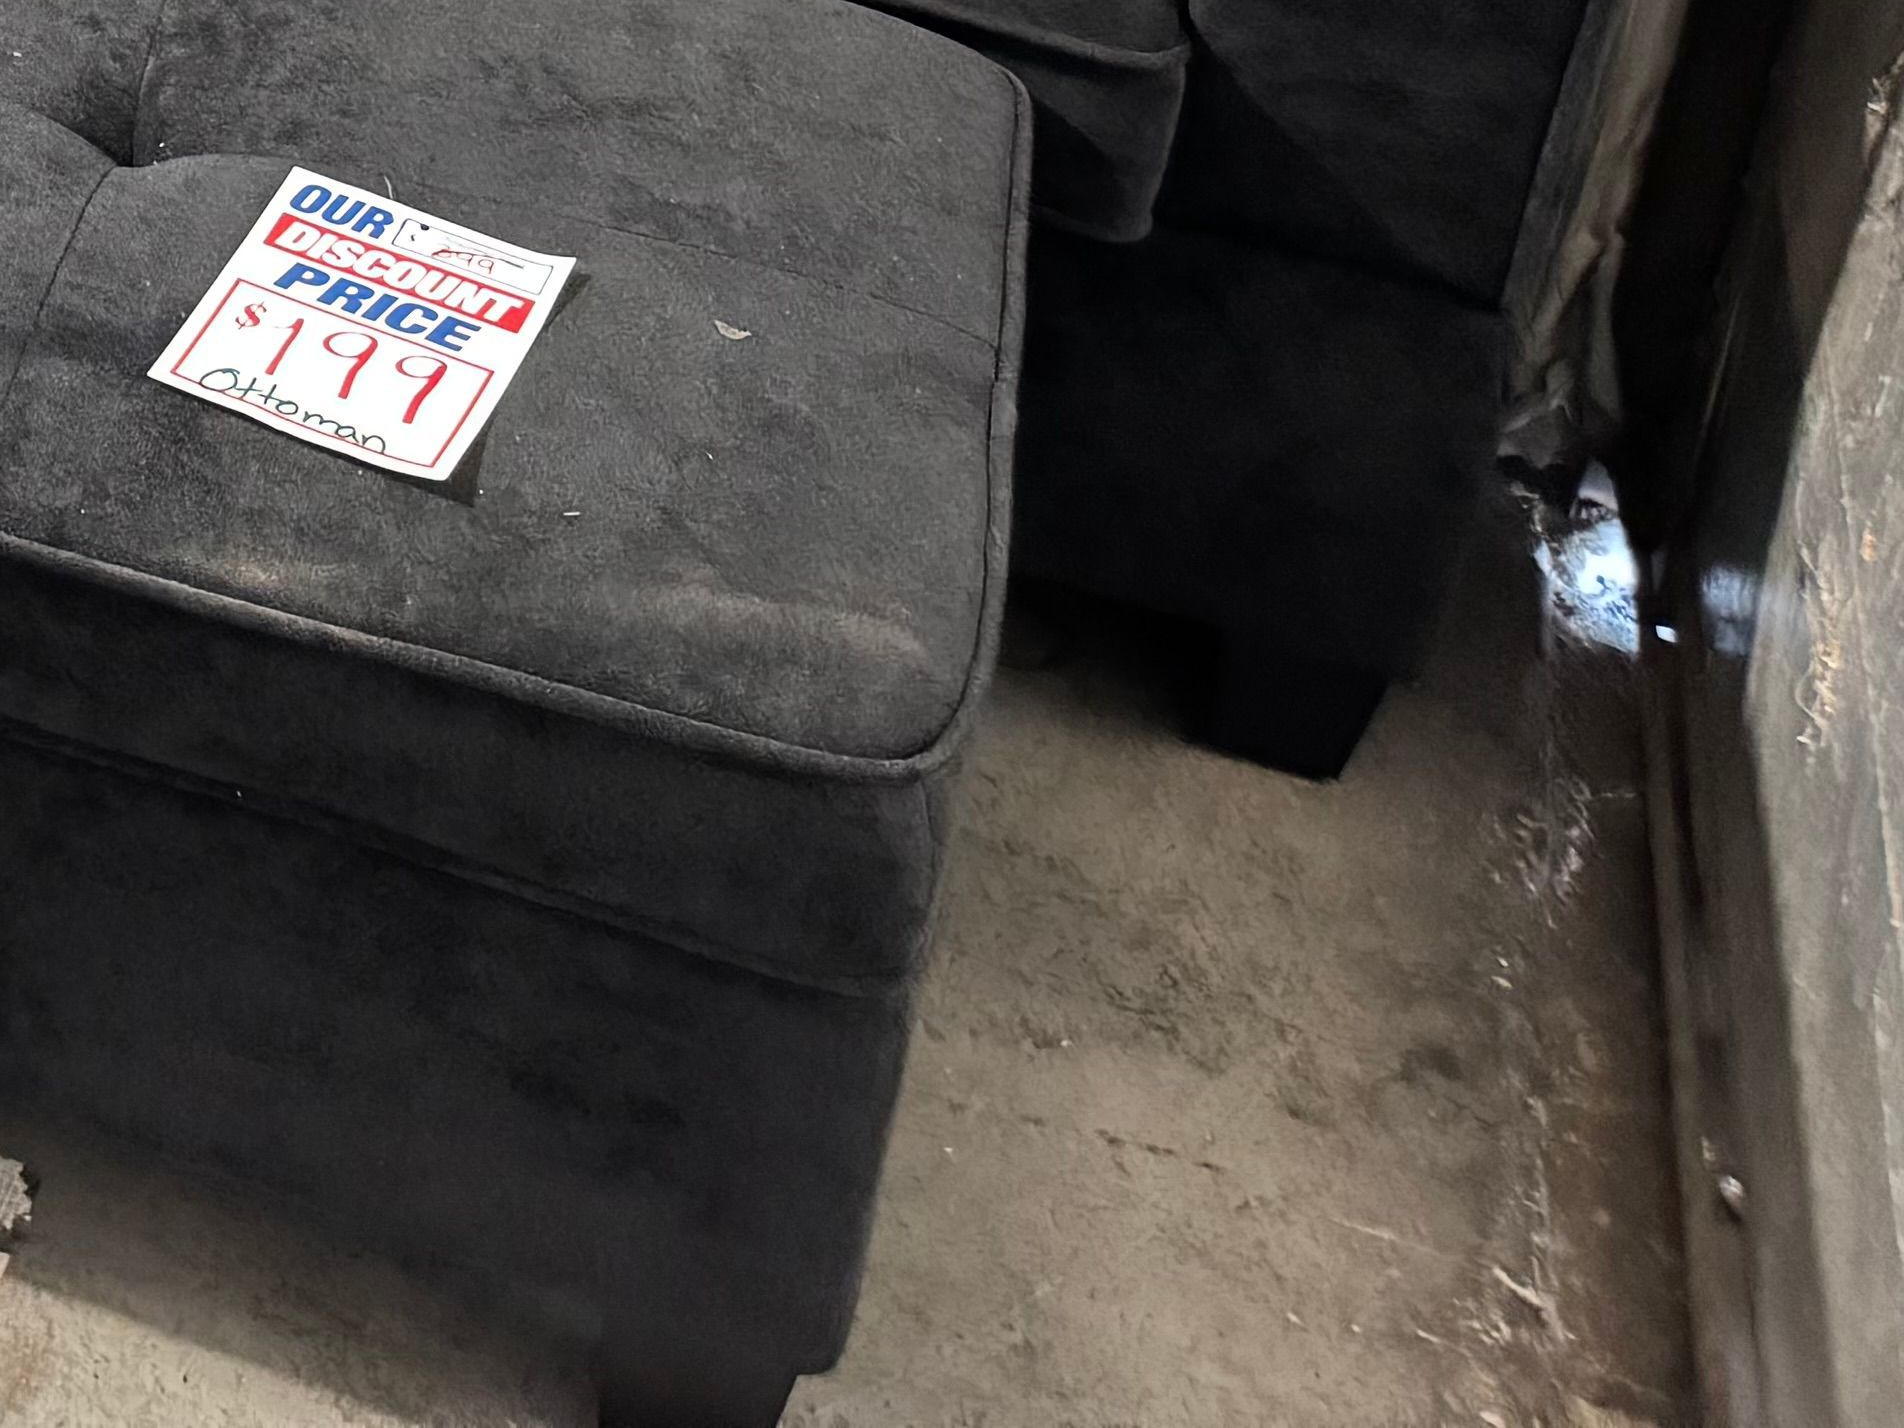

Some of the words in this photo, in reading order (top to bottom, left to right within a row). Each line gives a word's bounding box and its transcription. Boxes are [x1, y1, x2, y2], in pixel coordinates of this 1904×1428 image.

[288, 184, 395, 240] OUR
[273, 262, 483, 353] PRICE
[274, 220, 525, 325] DISCOUNT
[235, 300, 449, 425] $199
[198, 367, 387, 455] Ottoman
